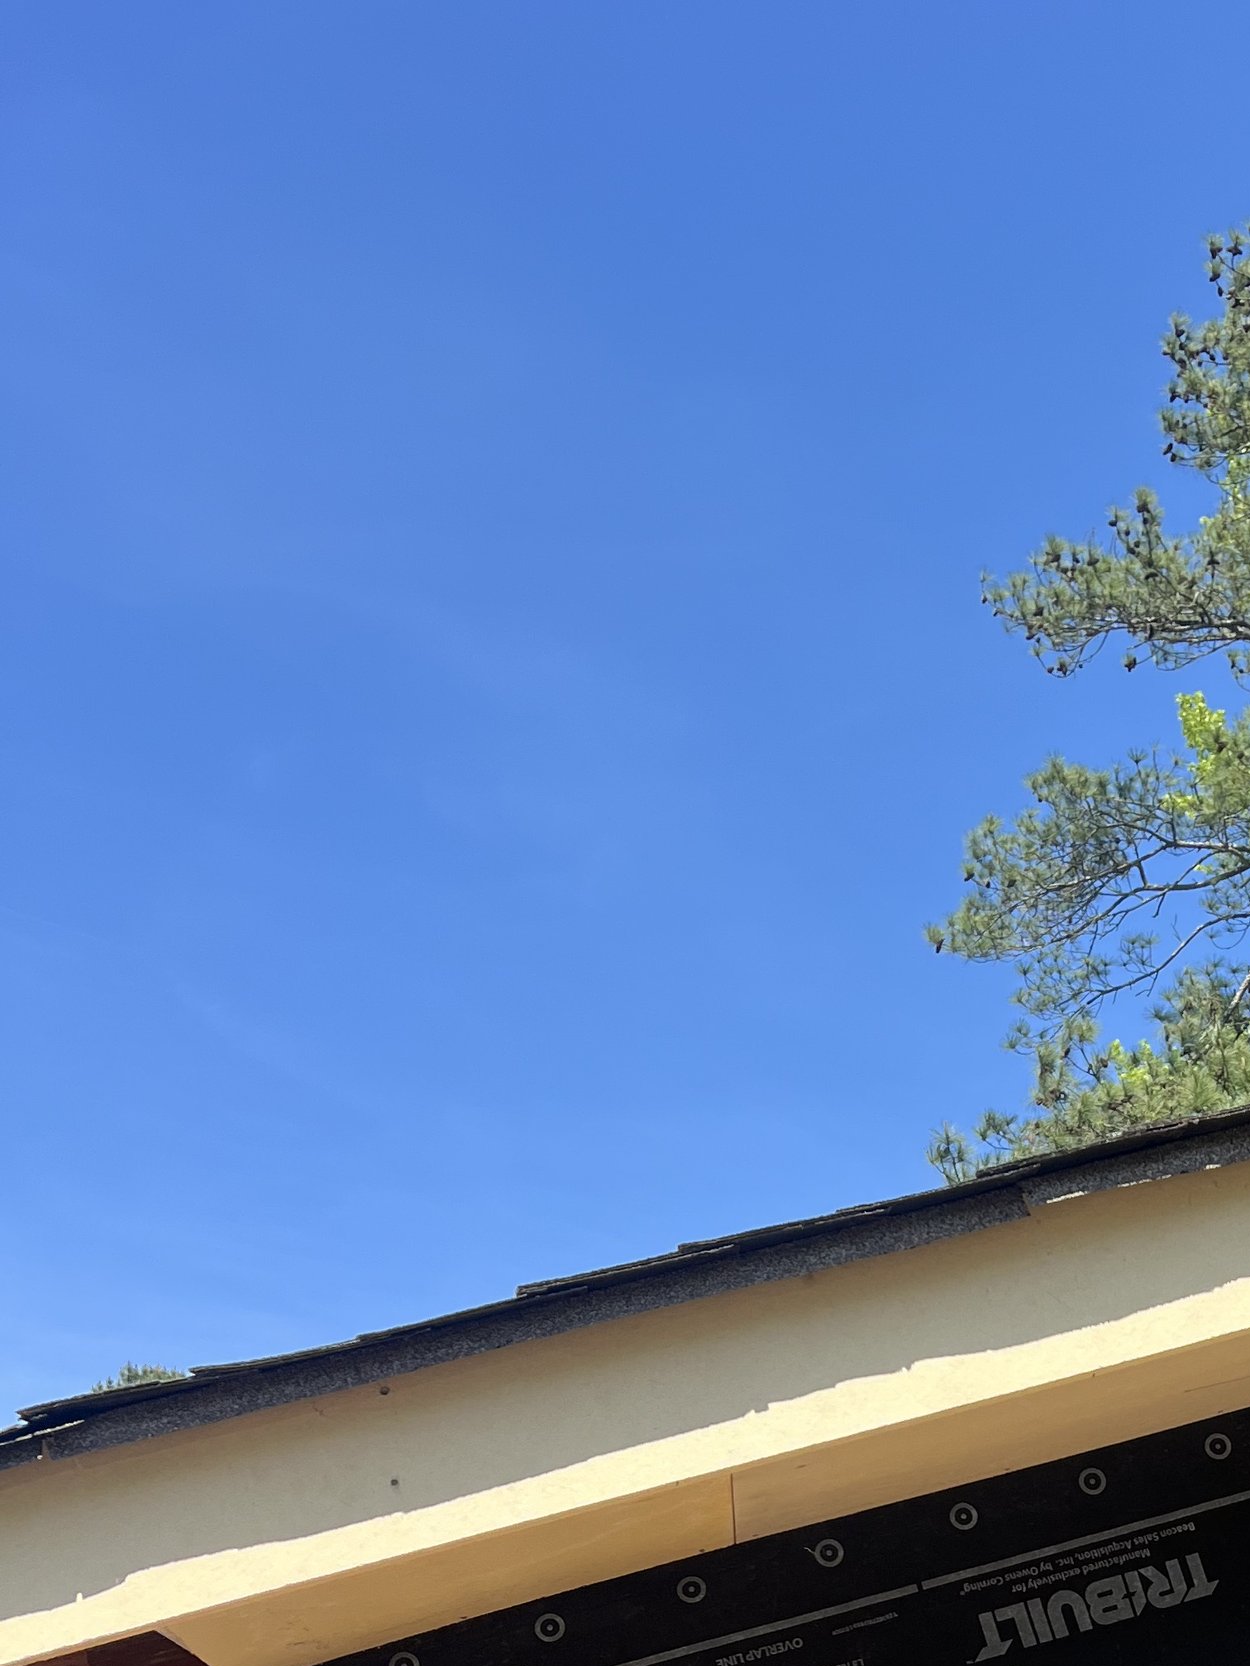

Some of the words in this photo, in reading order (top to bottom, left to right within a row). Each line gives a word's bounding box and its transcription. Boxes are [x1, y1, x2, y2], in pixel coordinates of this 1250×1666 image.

[1160, 1522, 1196, 1537] Beacon
[1133, 1532, 1159, 1545] Sales
[1074, 1539, 1132, 1560] Acquisition,
[1040, 1561, 1053, 1572] by
[1055, 1556, 1074, 1566] Inc.
[1082, 1548, 1151, 1575] Manufactured
[1004, 1566, 1039, 1581] Owens
[1028, 1568, 1081, 1589] exclusively
[1012, 1582, 1026, 1592] for
[975, 1552, 1219, 1663] TRIBUILT
[745, 1638, 803, 1661] OVERLAP
